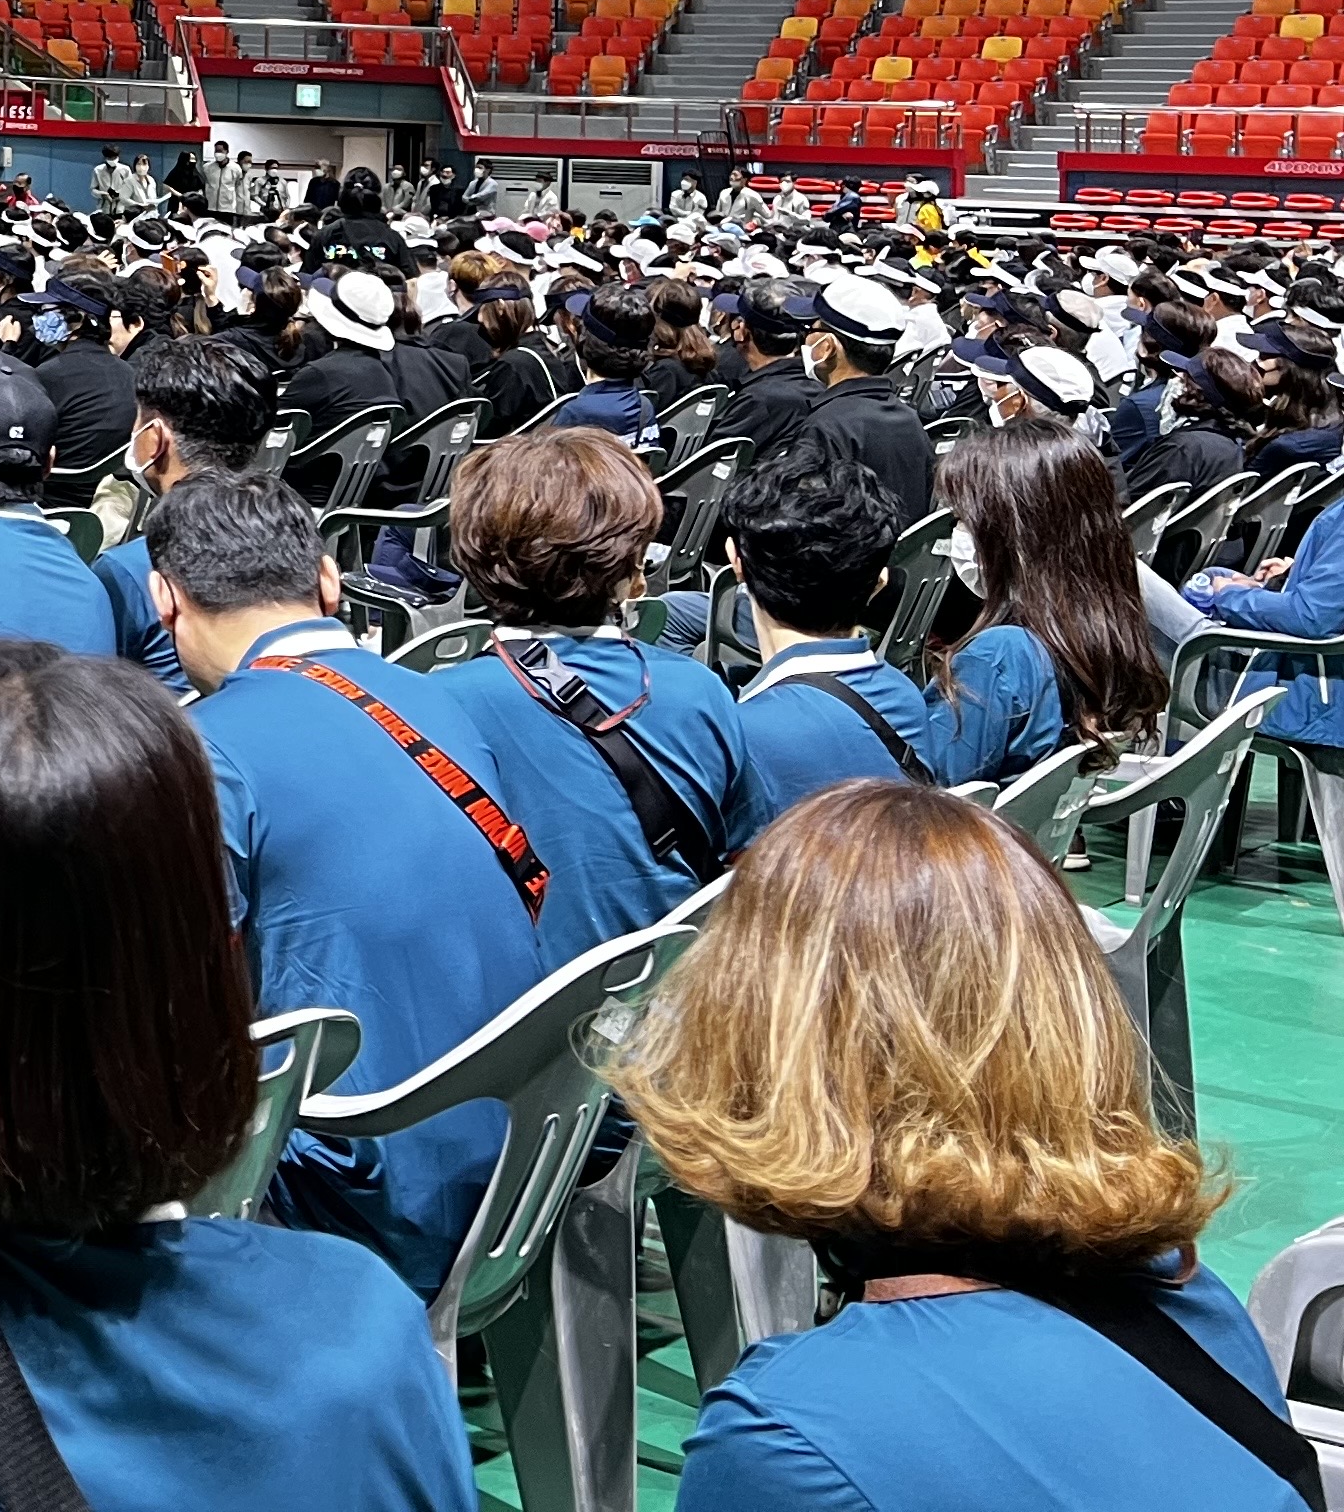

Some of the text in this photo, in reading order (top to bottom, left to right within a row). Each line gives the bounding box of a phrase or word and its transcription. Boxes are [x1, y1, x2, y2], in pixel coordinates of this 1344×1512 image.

[301, 664, 366, 700] NIKE
[364, 701, 421, 748] NIKE
[415, 748, 475, 799] NIKE
